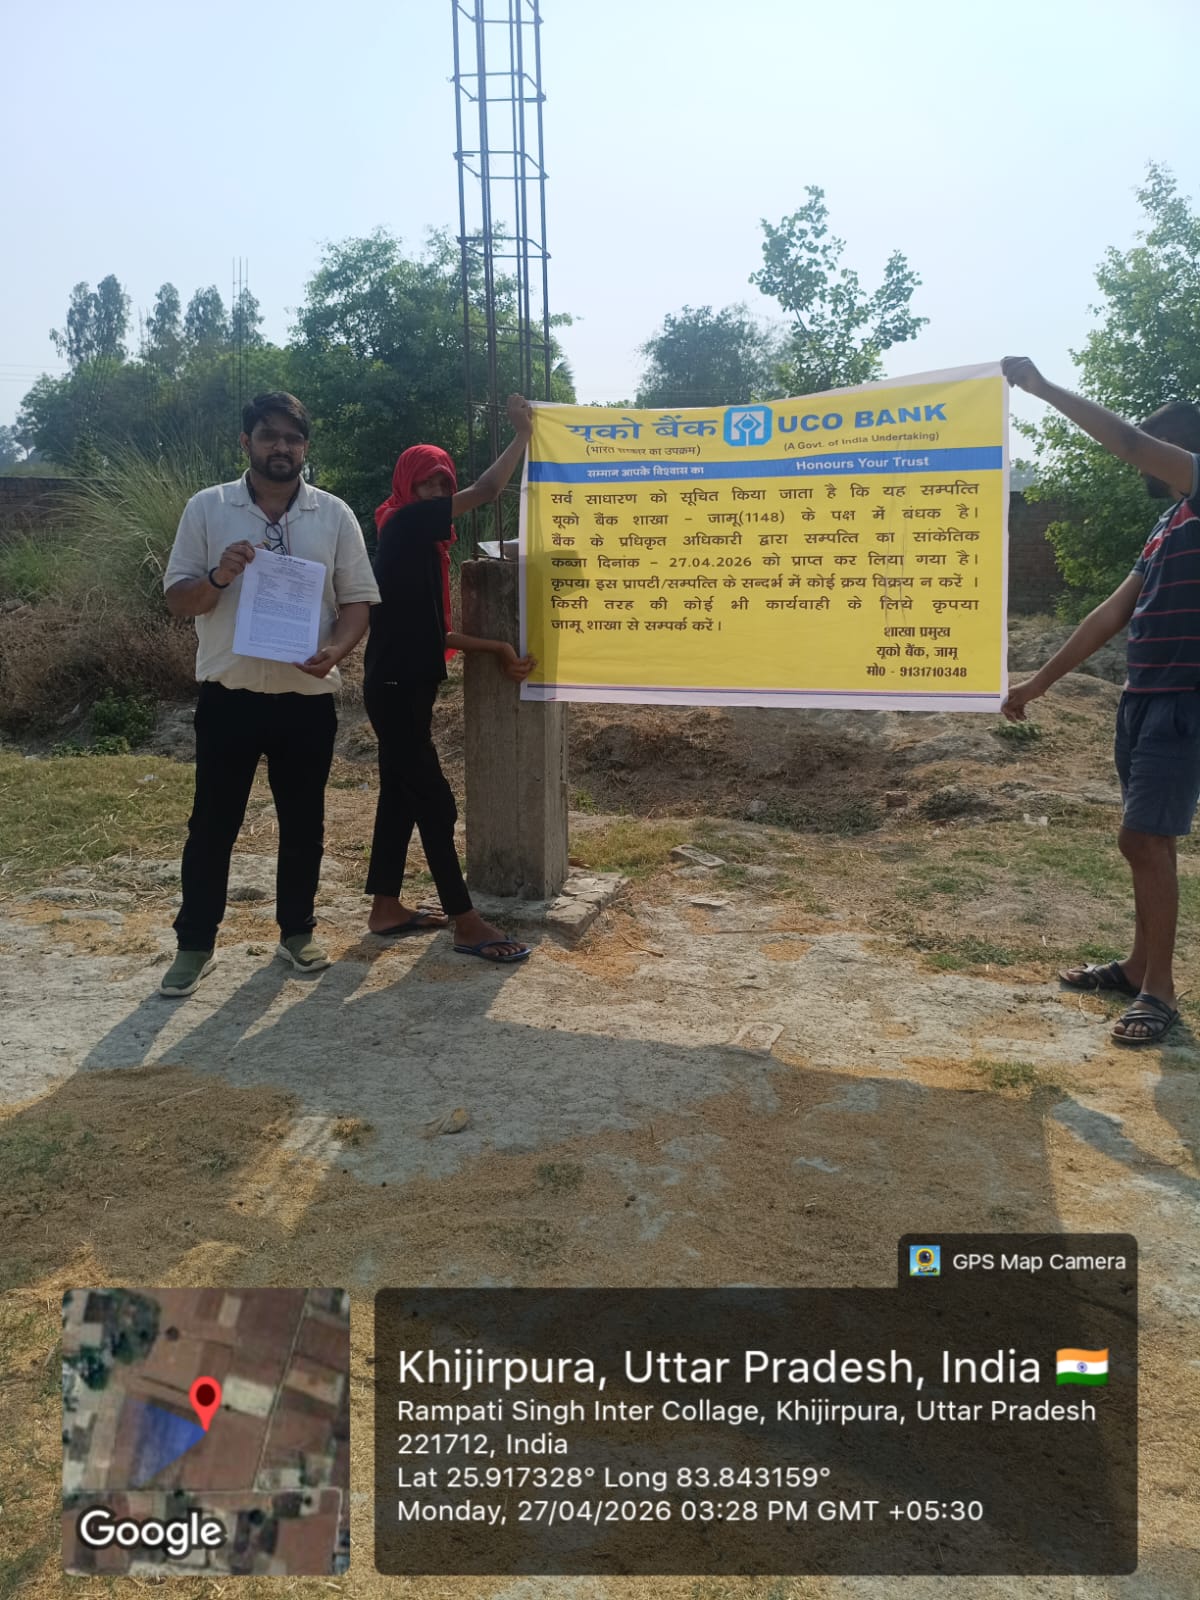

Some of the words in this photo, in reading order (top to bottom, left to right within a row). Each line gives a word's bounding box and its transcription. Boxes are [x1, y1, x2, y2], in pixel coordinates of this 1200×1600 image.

[778, 413, 843, 433] UCO
[855, 403, 947, 428] BANK
[565, 417, 643, 442] यूको
[652, 415, 718, 438] बैंक
[586, 445, 615, 456] (भारत
[649, 448, 662, 456] का
[664, 445, 701, 456] उपक्रम)
[784, 442, 795, 452] (A
[798, 441, 823, 450] Govt.
[828, 439, 839, 447] of
[842, 436, 868, 445] India
[872, 432, 940, 442] Undertaking)
[622, 467, 650, 477] आपके
[653, 466, 688, 476] विश्वास
[690, 466, 704, 475] का
[796, 461, 854, 471] Honours
[858, 458, 889, 468] Your
[892, 456, 929, 467] Trust
[551, 490, 573, 504] सर्व
[585, 494, 637, 505] साधारण
[650, 489, 667, 504] को
[680, 488, 719, 506] सूचित
[732, 487, 766, 500] किया
[780, 488, 813, 499] जाता
[825, 483, 837, 499] है
[850, 483, 870, 498] कि
[883, 486, 906, 498] यह
[920, 480, 979, 496] सम्पत्ति
[552, 512, 579, 529] यूको
[594, 512, 618, 526] बैंक
[633, 514, 668, 525] शाखा
[801, 507, 816, 522] के
[831, 510, 855, 521] पक्ष
[872, 506, 885, 520] में
[903, 506, 942, 520] बंधक
[552, 533, 575, 547] बैंक
[590, 533, 604, 547] के
[683, 532, 742, 546] अधिकारी
[758, 535, 788, 546] द्वारा
[804, 529, 860, 544] सम्पत्ति
[876, 532, 895, 543] का
[913, 527, 981, 542] सांकेतिक
[551, 558, 587, 568] कब्जा
[598, 555, 640, 568] दिनांक
[669, 557, 752, 568] 27.04.2026
[762, 552, 781, 566] को
[792, 555, 823, 566] प्राप्त
[834, 555, 856, 566] कर
[868, 551, 904, 565] लिया
[916, 554, 946, 565] गया
[551, 578, 589, 593] कृपया
[596, 579, 617, 591] इस
[723, 574, 737, 589] के
[741, 573, 783, 588] सन्दर्भ
[788, 574, 801, 588] में
[807, 573, 836, 589] कोई
[841, 577, 866, 588] क्रय
[873, 574, 914, 588] विक्रय
[920, 577, 932, 587] न
[939, 574, 963, 587] करें
[551, 596, 588, 609] किसी
[605, 600, 634, 610] तरह
[650, 597, 668, 610] की
[684, 596, 714, 611] कोई
[731, 597, 749, 610] भी
[766, 596, 830, 610] कार्यवाही
[848, 596, 862, 609] के
[880, 596, 913, 610] लिये
[932, 600, 979, 613] कृपया
[551, 620, 584, 634] जामू
[587, 620, 621, 631] शाखा
[627, 618, 639, 631] से
[645, 618, 688, 631] सम्पर्क
[884, 626, 915, 637] शाखा
[920, 626, 951, 640] प्रमुख
[876, 642, 901, 659] यूको
[905, 642, 929, 658] बैंक,
[934, 647, 958, 660] जामू
[900, 667, 967, 678] 9131710348
